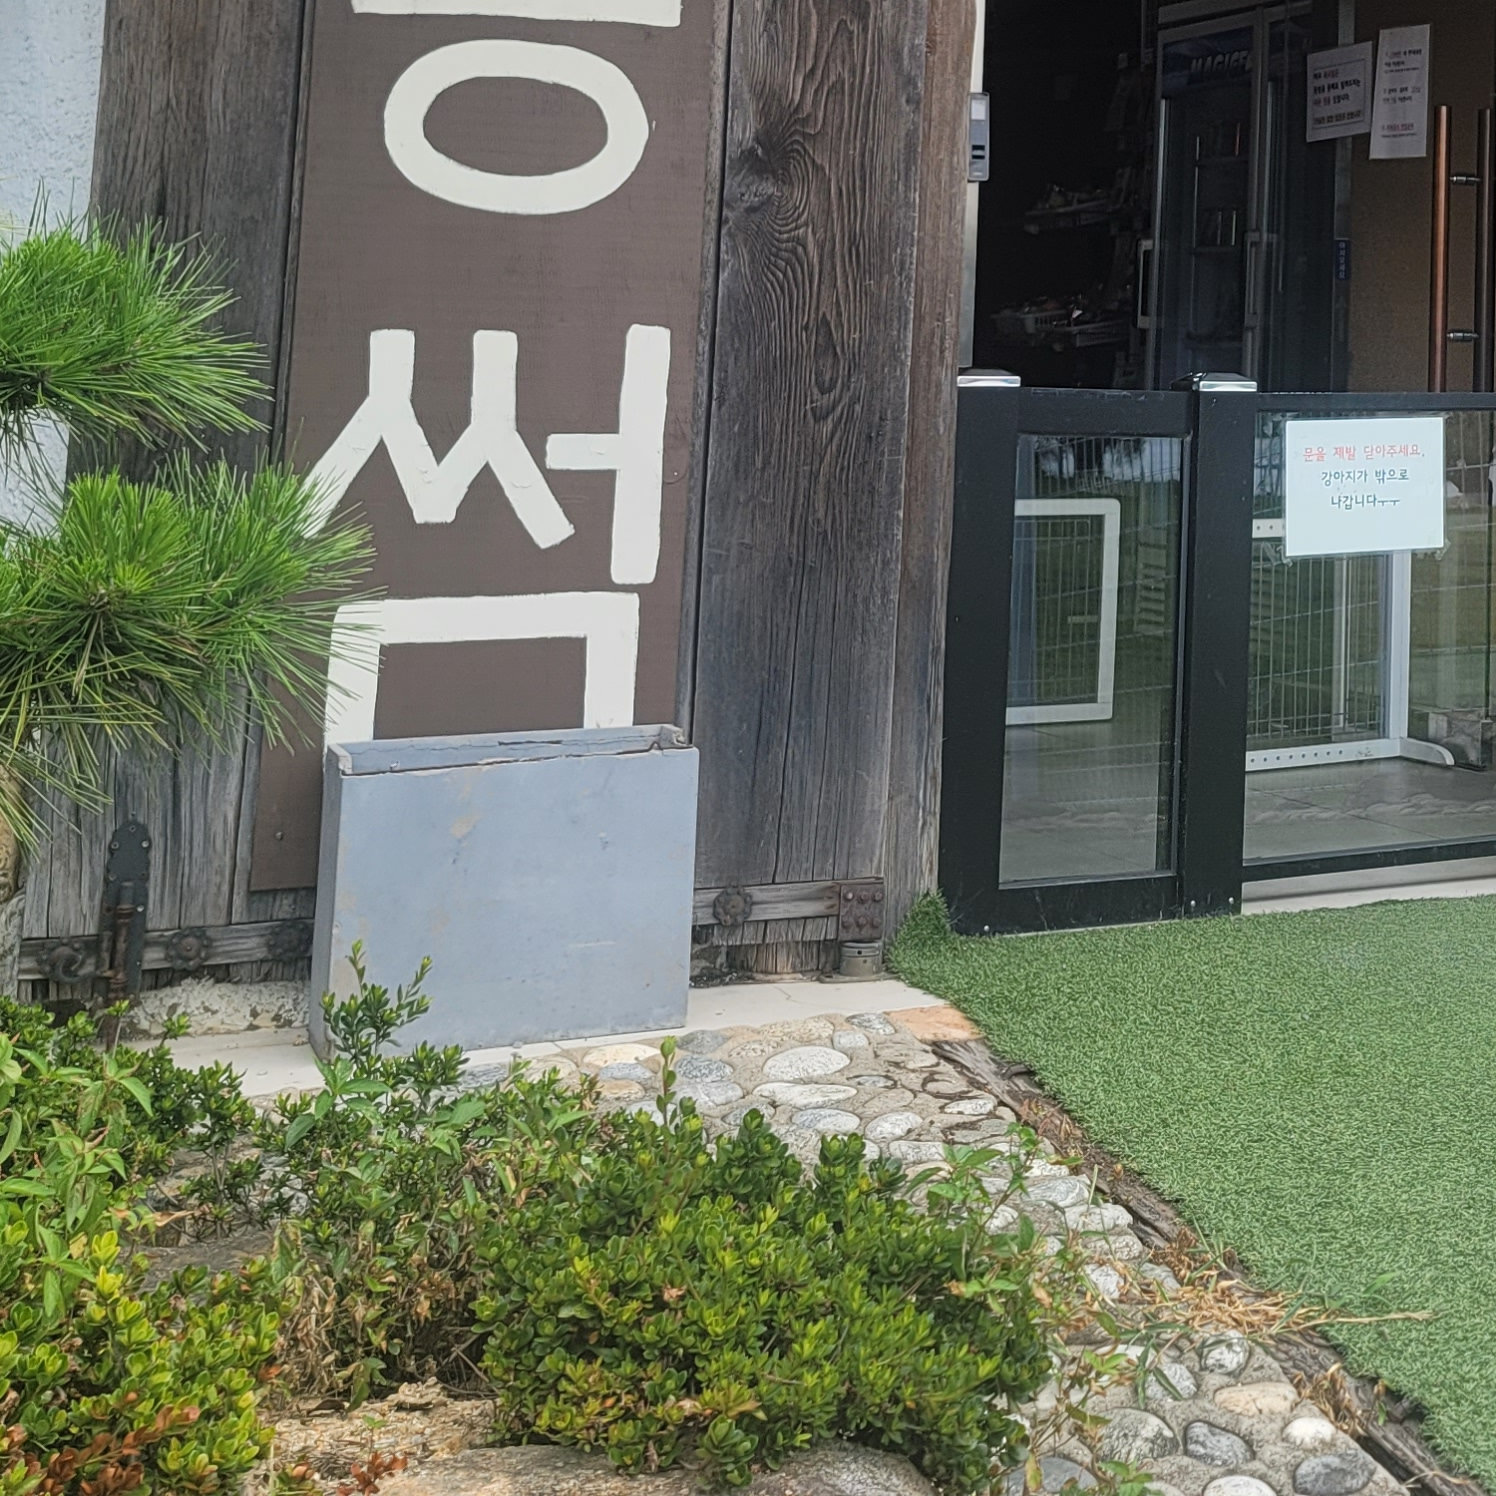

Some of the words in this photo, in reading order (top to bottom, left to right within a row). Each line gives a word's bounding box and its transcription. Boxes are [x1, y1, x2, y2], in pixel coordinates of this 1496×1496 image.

[1302, 446, 1327, 462] 문을
[1333, 445, 1357, 461] 제발
[1363, 444, 1425, 461] 닫아주세요.
[1320, 469, 1368, 487] 강아지가
[1374, 468, 1410, 485] 밖으로
